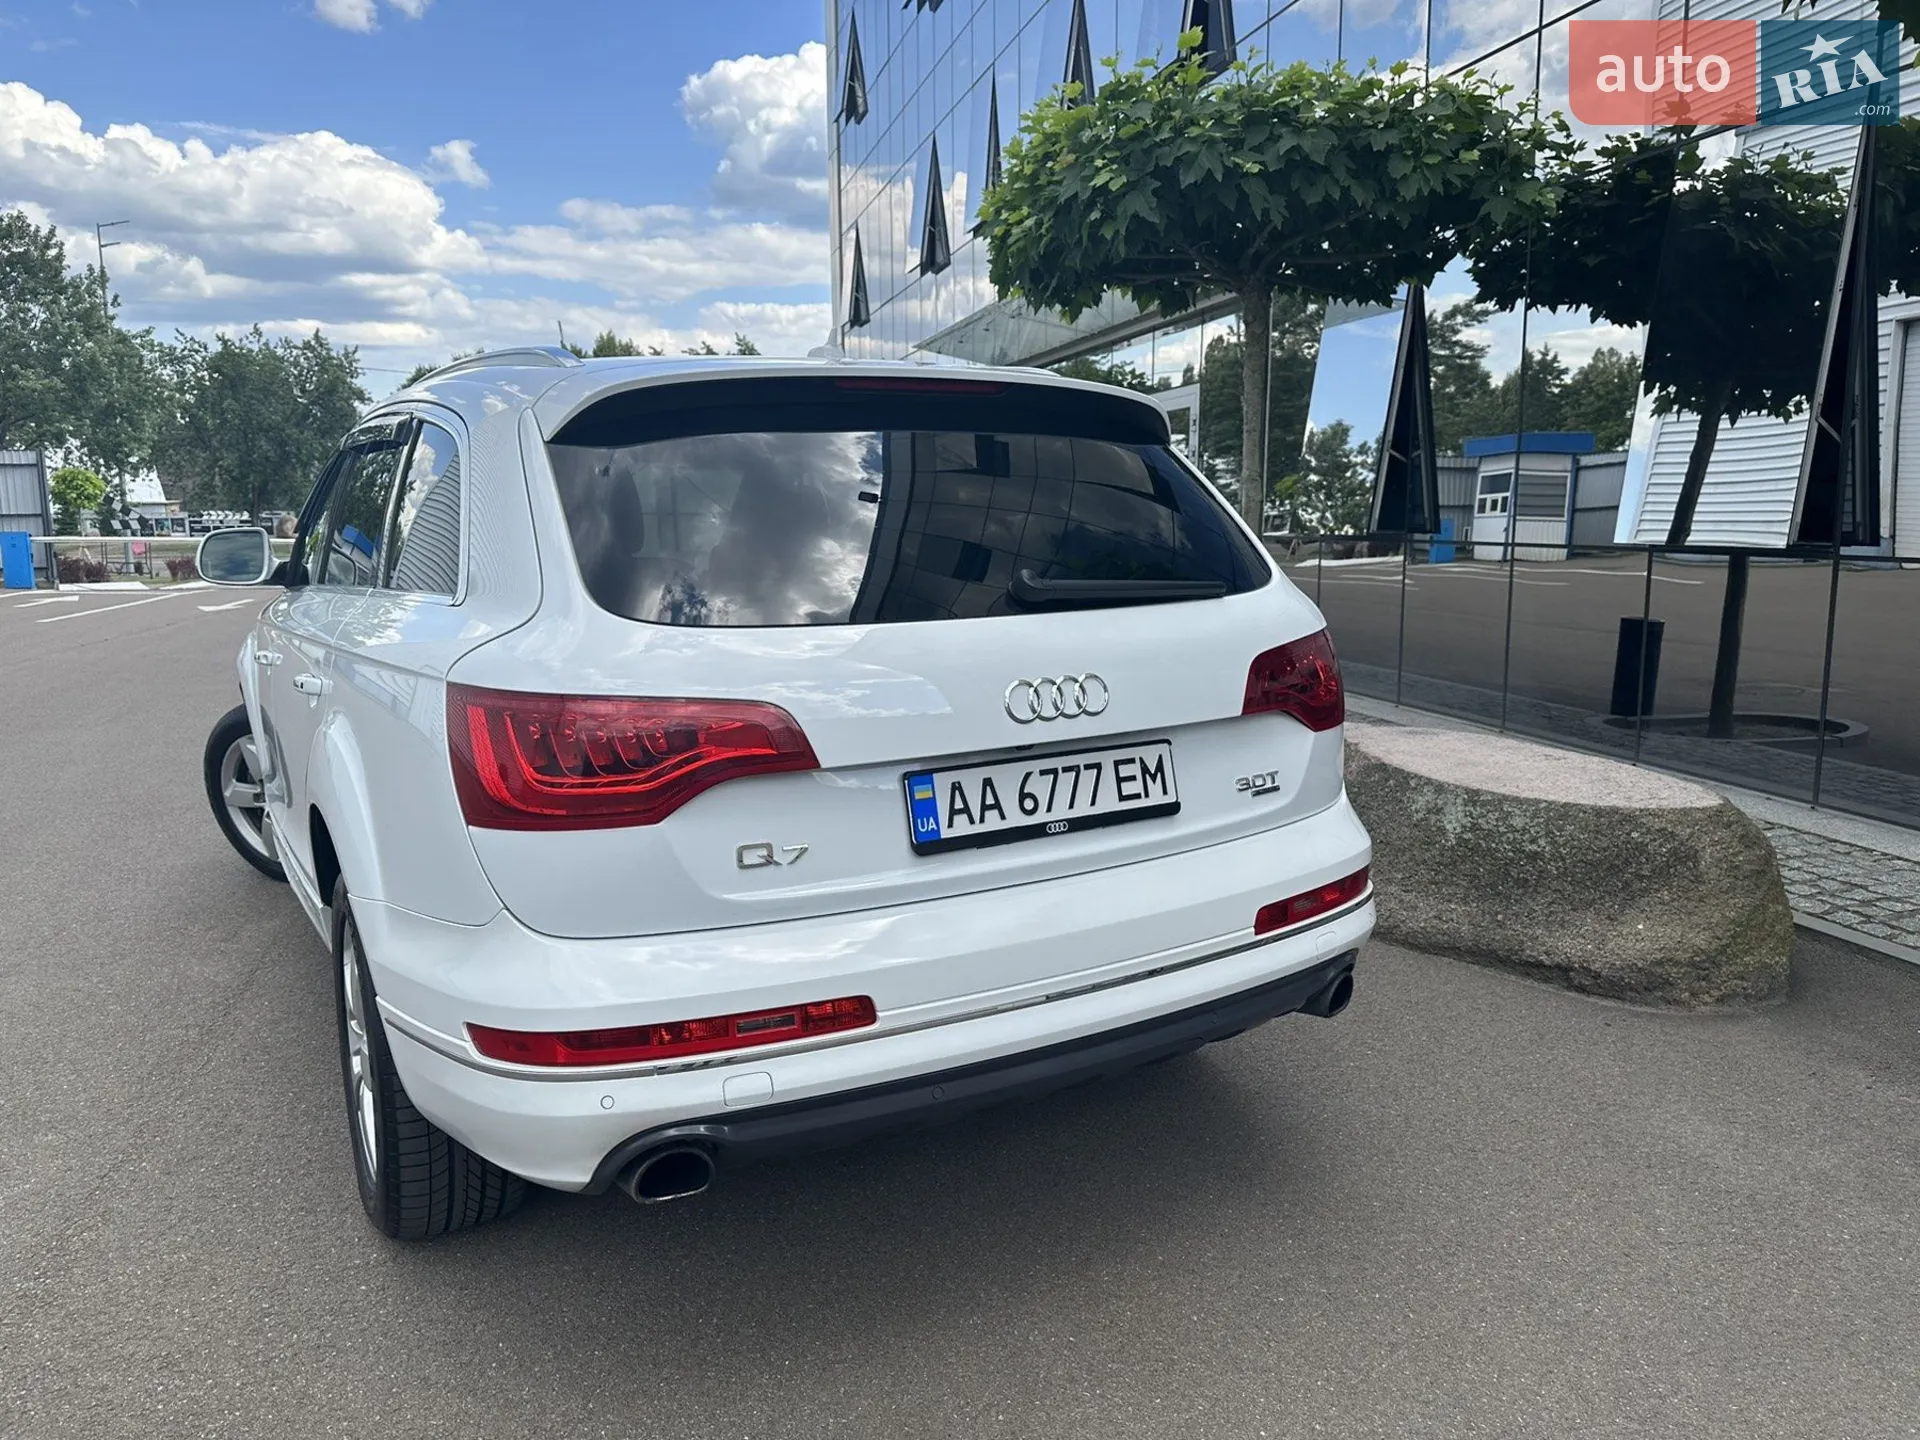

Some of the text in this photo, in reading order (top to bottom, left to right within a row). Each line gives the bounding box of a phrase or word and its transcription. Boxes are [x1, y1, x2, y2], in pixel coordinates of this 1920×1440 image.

[946, 753, 1168, 829] AA 6777 EM
[917, 818, 938, 833] UA
[736, 841, 810, 870] Q7
